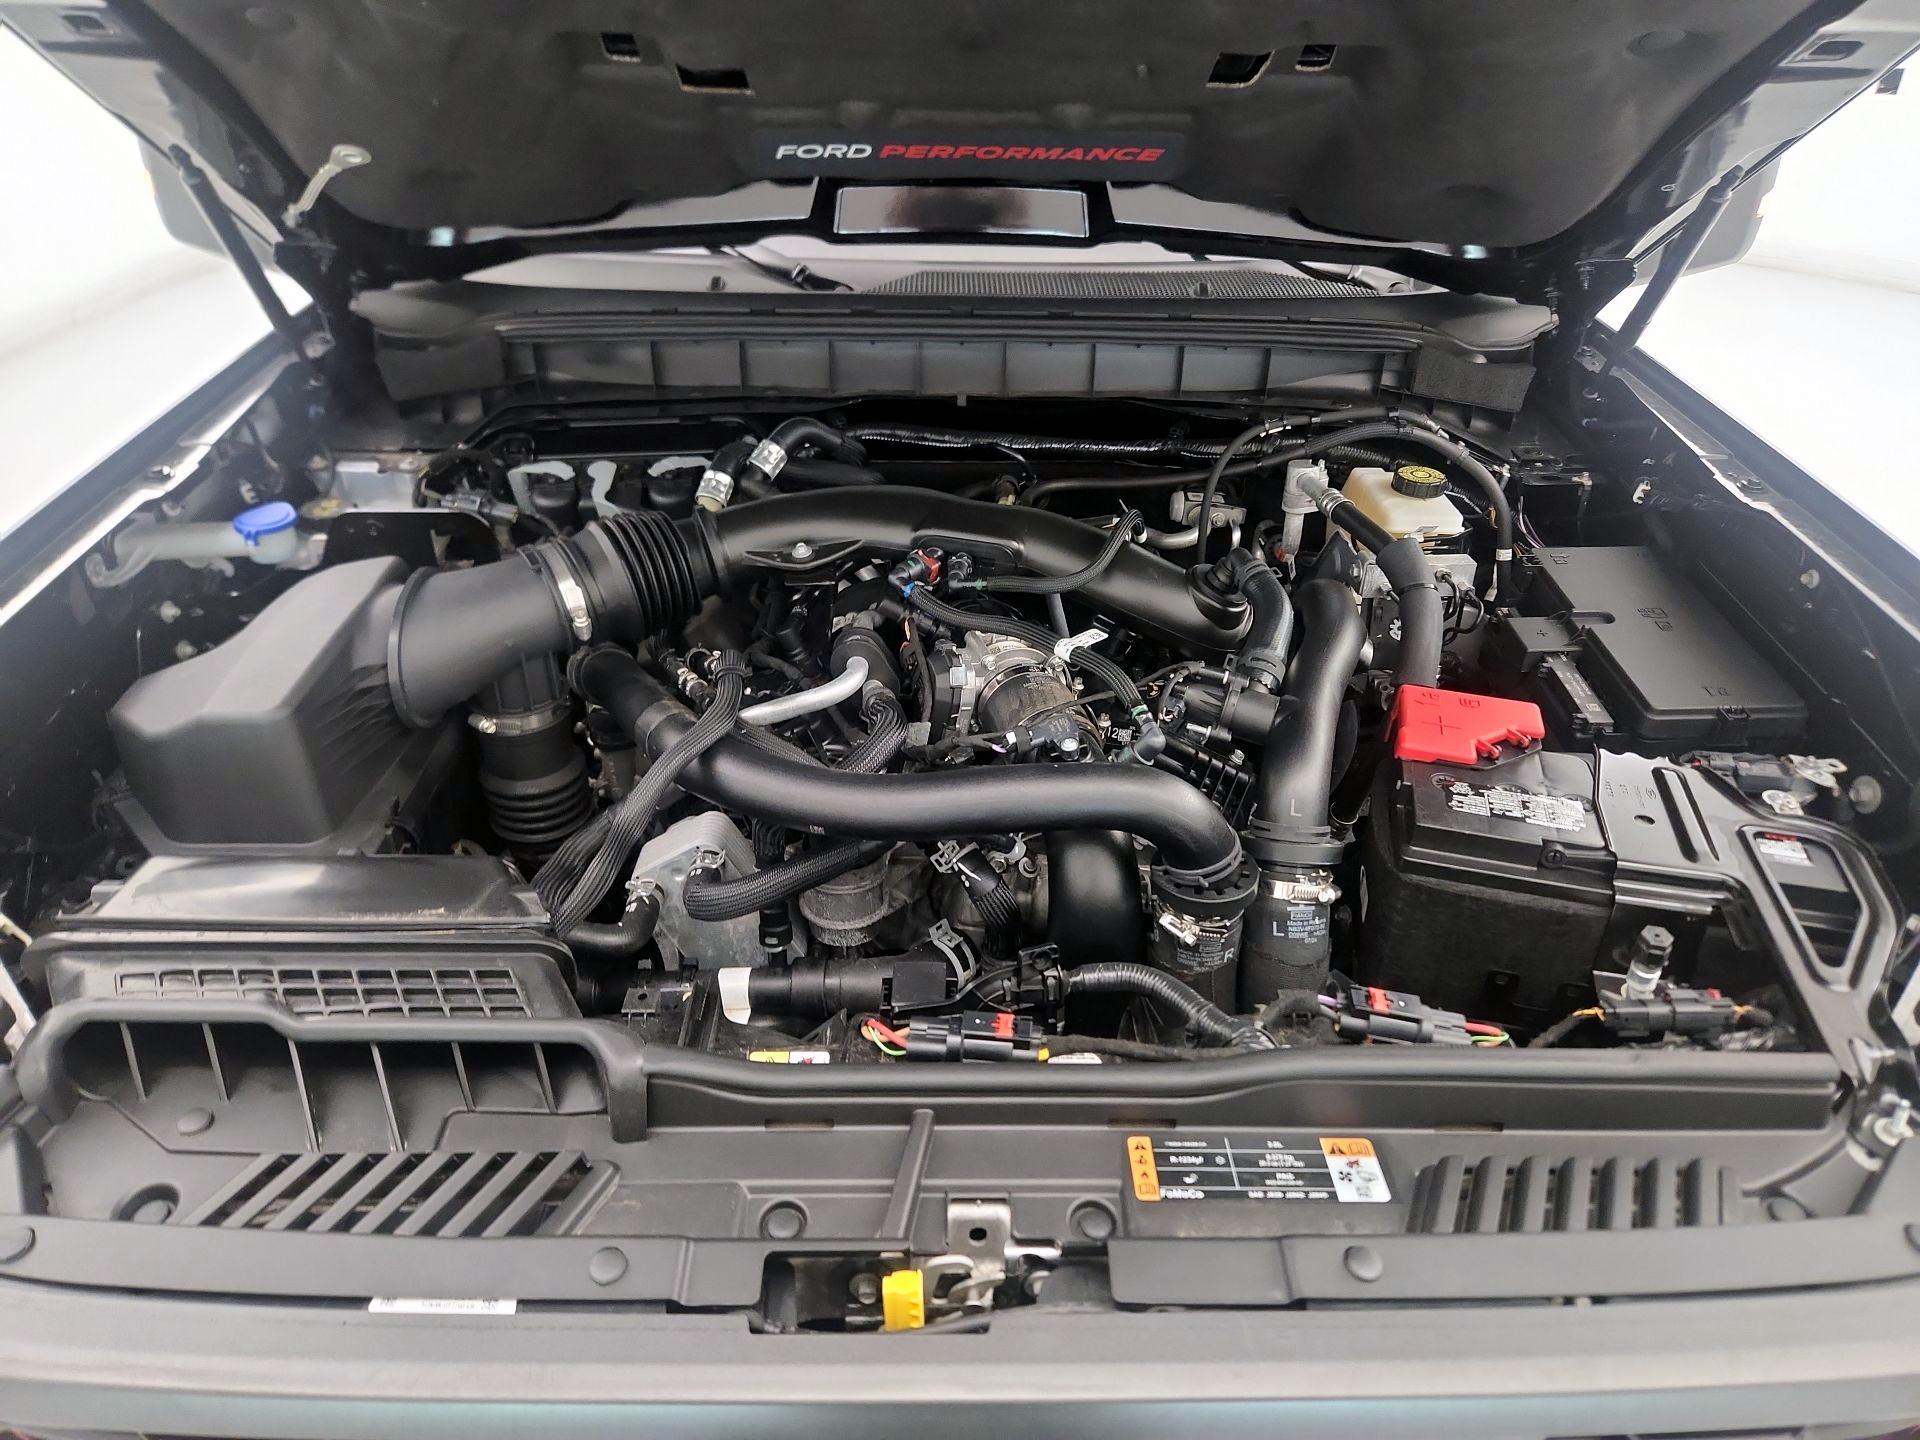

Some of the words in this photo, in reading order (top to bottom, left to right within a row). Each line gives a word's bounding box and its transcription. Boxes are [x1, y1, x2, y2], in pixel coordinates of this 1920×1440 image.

[775, 143, 872, 160] FORD
[879, 144, 1166, 163] PERFORMANCE
[1289, 798, 1303, 817] L
[1272, 921, 1285, 937] L
[1223, 947, 1235, 963] R
